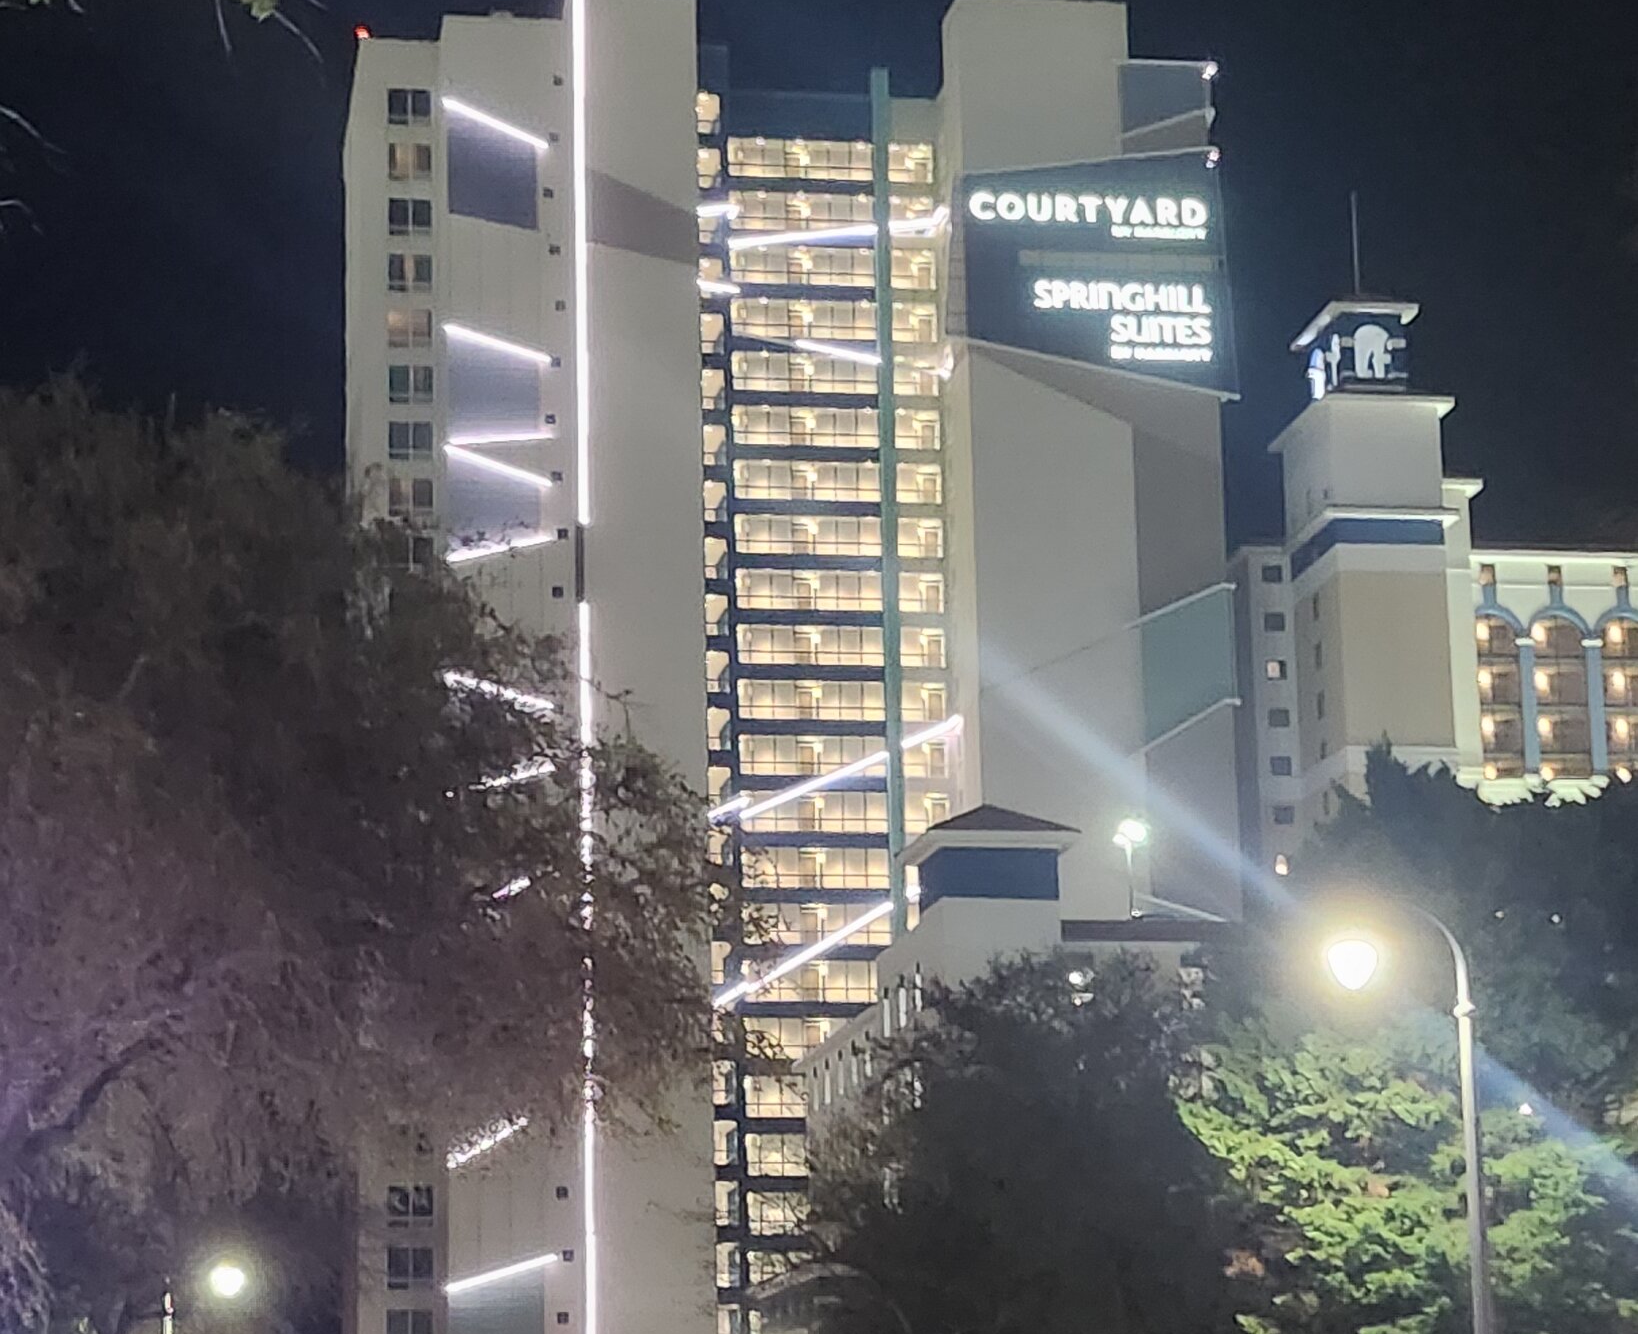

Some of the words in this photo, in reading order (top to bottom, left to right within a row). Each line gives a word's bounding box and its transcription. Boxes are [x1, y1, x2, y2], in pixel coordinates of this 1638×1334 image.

[968, 190, 1208, 226] COURTYARD
[1033, 279, 1212, 313] SPRINGHILL
[1110, 314, 1212, 344] SUITES
